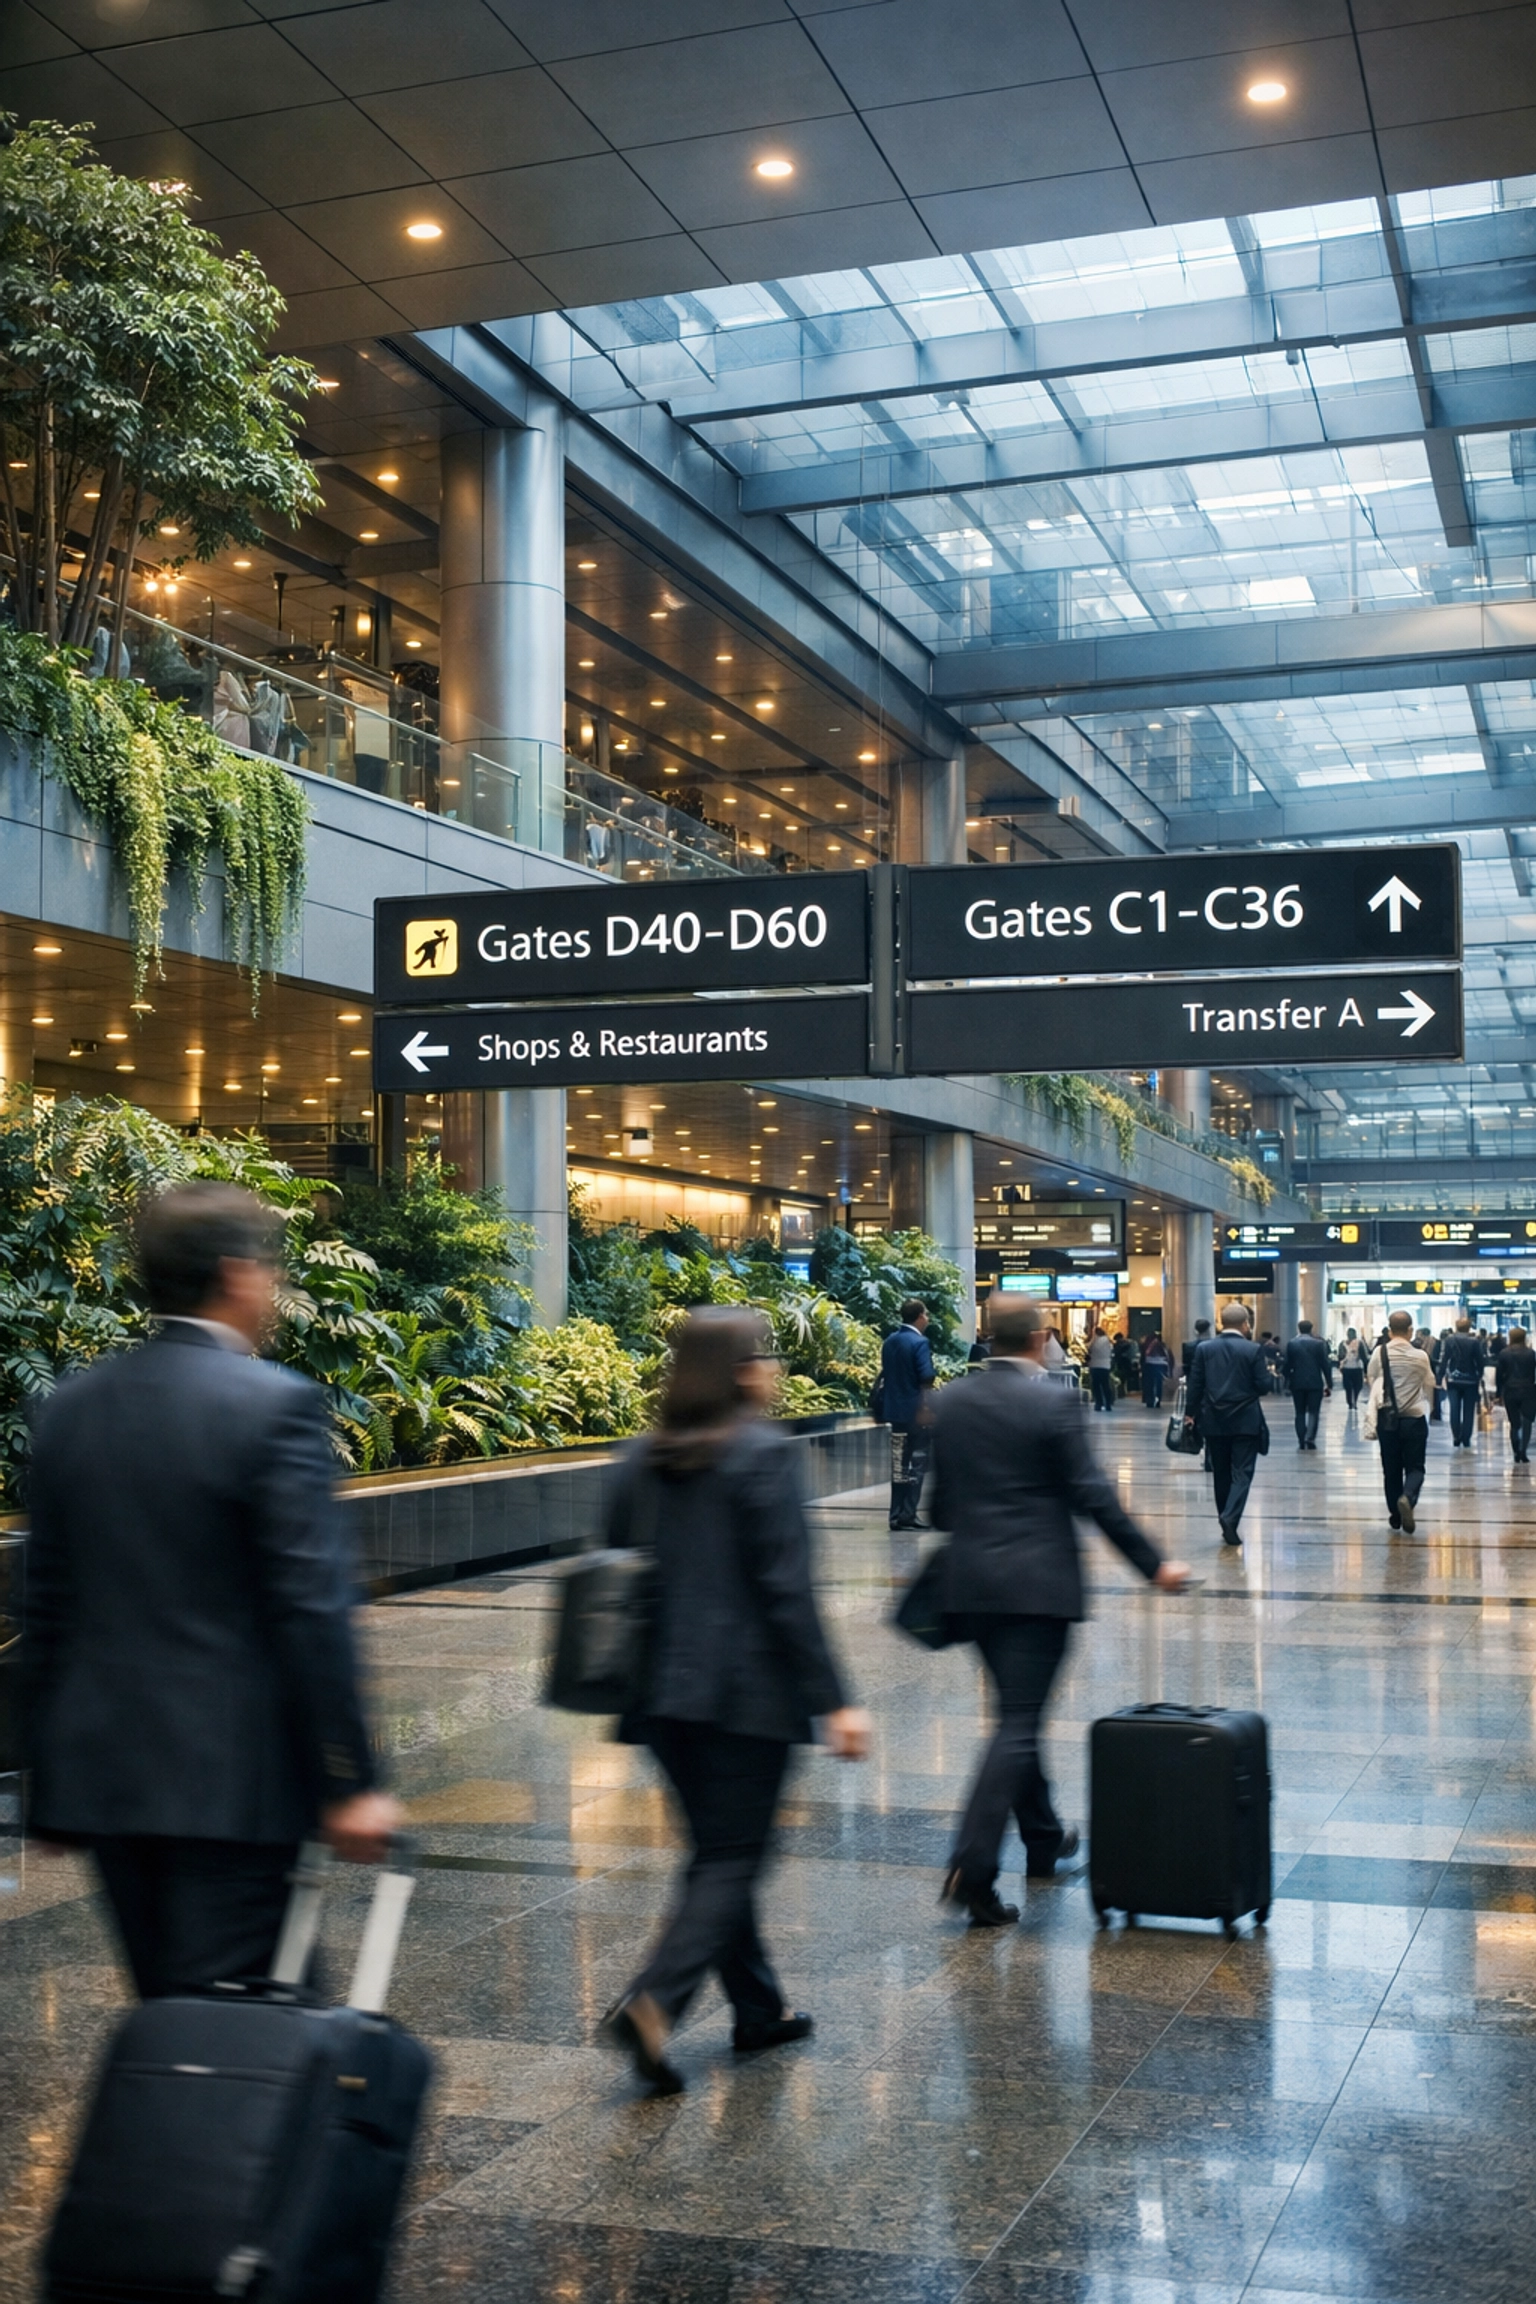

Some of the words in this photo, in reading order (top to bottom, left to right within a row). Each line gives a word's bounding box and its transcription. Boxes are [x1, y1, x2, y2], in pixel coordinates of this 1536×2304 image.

[478, 925, 591, 963] Gates
[607, 905, 828, 957] D40-D60
[965, 900, 1093, 940] Gates
[1109, 885, 1304, 935] C1-C36
[1182, 999, 1328, 1033] Transfer
[1338, 998, 1365, 1028] A
[478, 1034, 561, 1067] Shops
[570, 1031, 591, 1058] &
[601, 1027, 768, 1057] Restaurants
